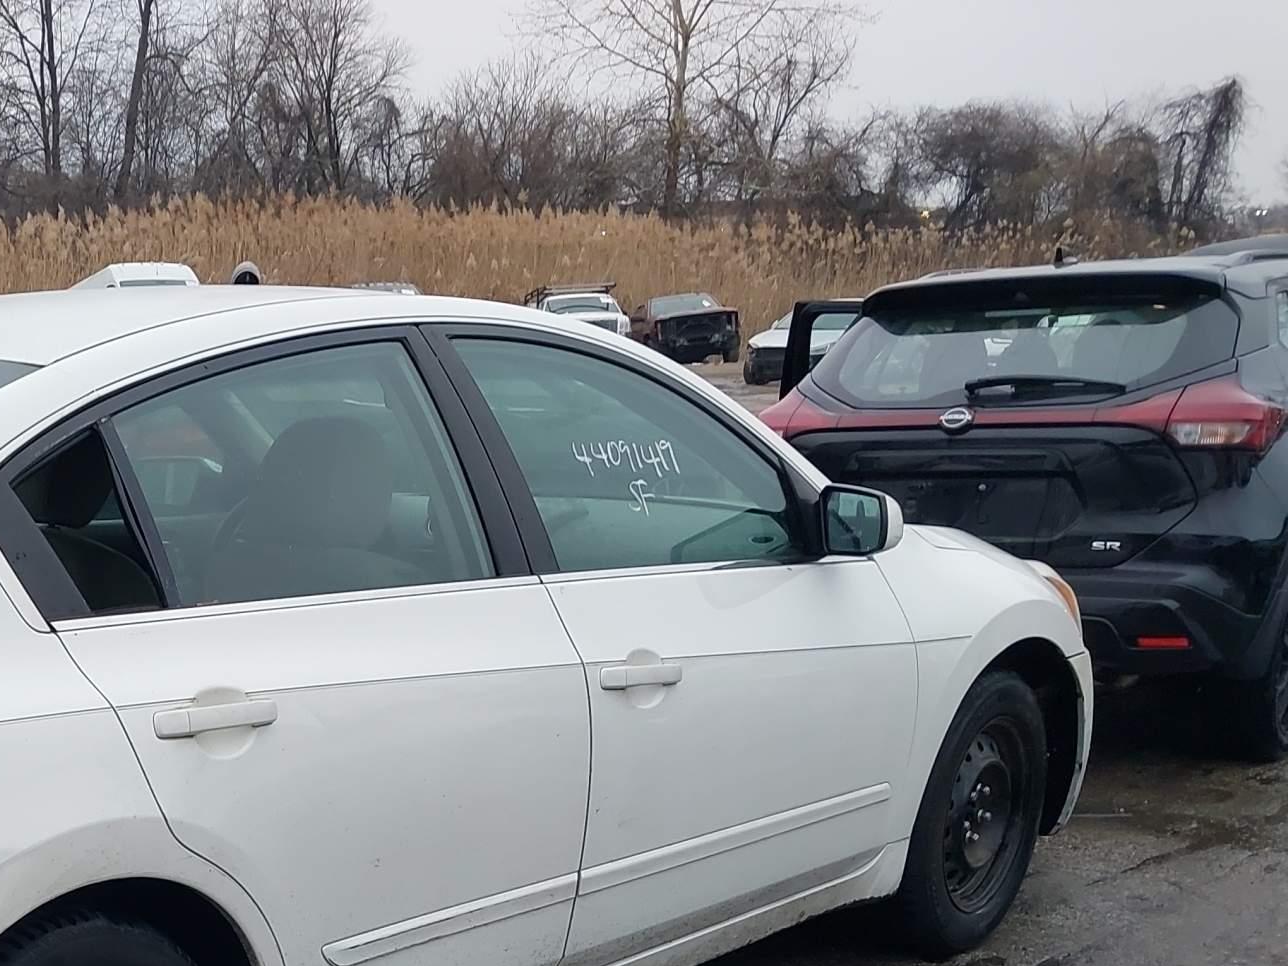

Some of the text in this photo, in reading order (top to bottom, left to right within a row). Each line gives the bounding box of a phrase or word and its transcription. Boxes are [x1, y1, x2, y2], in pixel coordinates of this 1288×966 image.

[571, 439, 681, 478] 44091419
[628, 479, 656, 517] SF
[1090, 540, 1121, 552] SR
